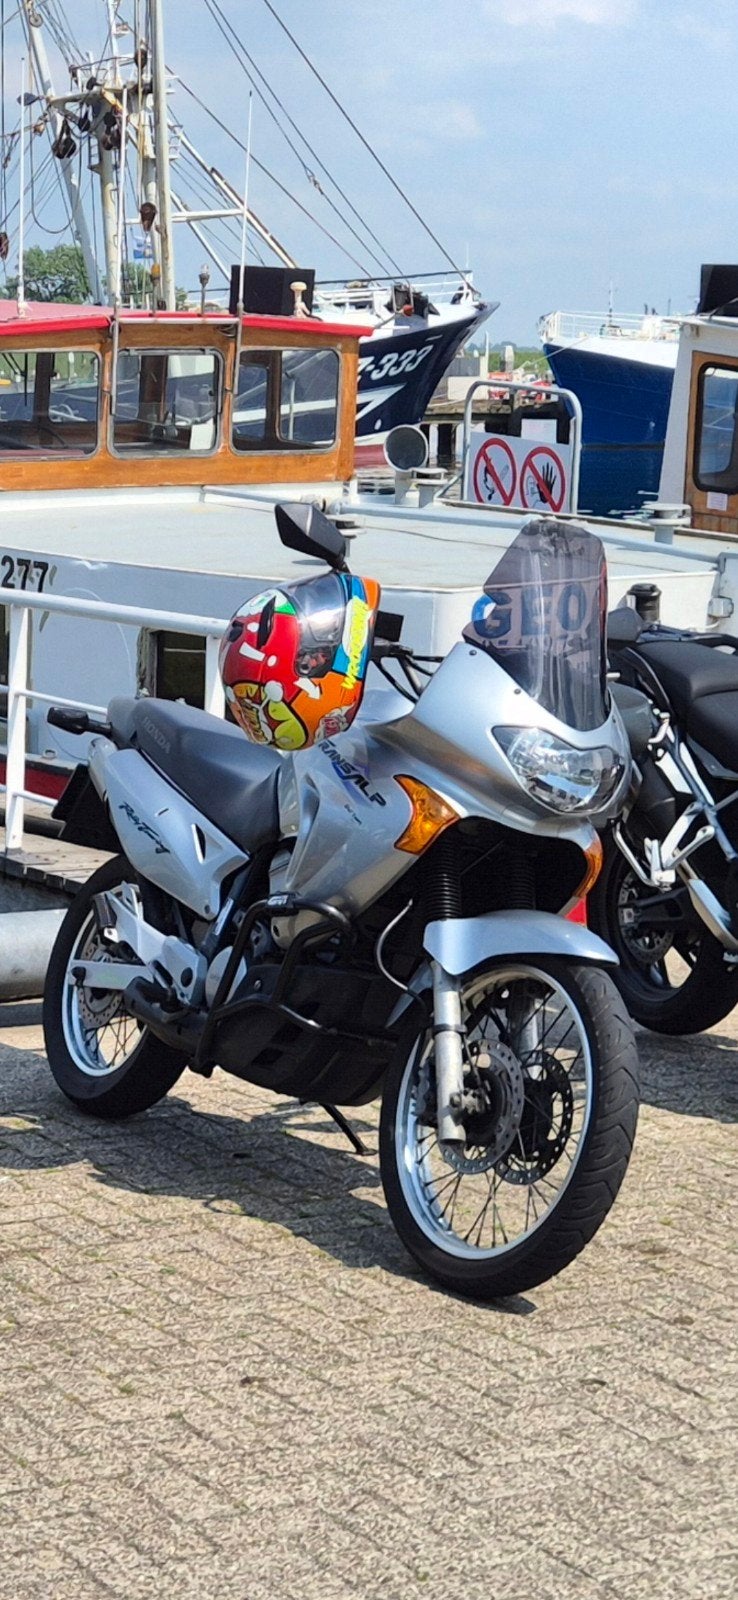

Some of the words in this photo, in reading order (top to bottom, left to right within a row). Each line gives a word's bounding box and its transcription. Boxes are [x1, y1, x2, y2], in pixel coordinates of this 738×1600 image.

[1, 555, 49, 593] 277
[143, 716, 173, 754] HONDA
[318, 739, 387, 806] TRANSALP
